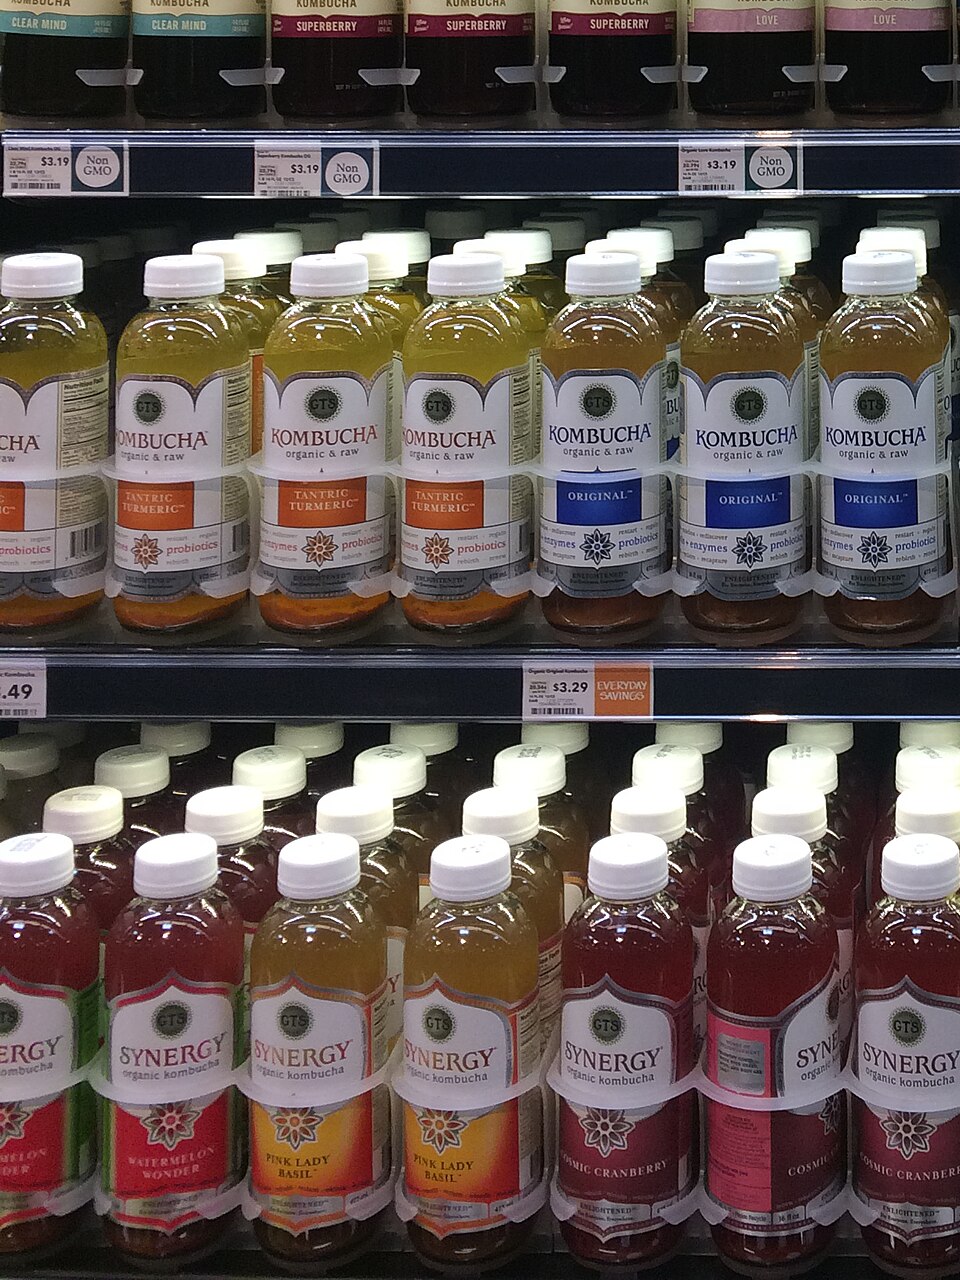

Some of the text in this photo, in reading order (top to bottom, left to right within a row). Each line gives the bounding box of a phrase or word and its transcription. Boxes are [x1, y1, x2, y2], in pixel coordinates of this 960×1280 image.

[152, 20, 207, 31] CLEAR MIND
[756, 14, 778, 25] LOVE
[296, 21, 357, 32] SUPERBERRY
[41, 157, 69, 167] $3.19
[86, 155, 108, 165] Non
[83, 166, 111, 175] GMO
[272, 426, 377, 448] KOMBUCHA
[549, 424, 651, 445] KOMBUCHA
[286, 448, 359, 461] organic & raw
[563, 446, 634, 459] organic & raw
[294, 489, 349, 500] TANTRIC
[568, 491, 627, 501] ORIGINAL
[289, 499, 353, 511] TURMERIC
[553, 682, 588, 692] $3.29
[597, 681, 647, 691] EVERYDAY
[600, 691, 645, 700] SAVINGS
[120, 1036, 224, 1067] SYNERGY
[255, 1039, 350, 1065] SYNERGY
[565, 1041, 660, 1071] SYNERGY
[123, 1060, 220, 1081] organic kombucha
[568, 1070, 654, 1086] organic kombucha
[128, 1147, 215, 1168] WATERMELON
[266, 1154, 329, 1167] PINK LADY
[142, 1164, 200, 1179] WONDER
[279, 1168, 313, 1178] BASIL
[594, 1161, 668, 1179] CRANBERRY
